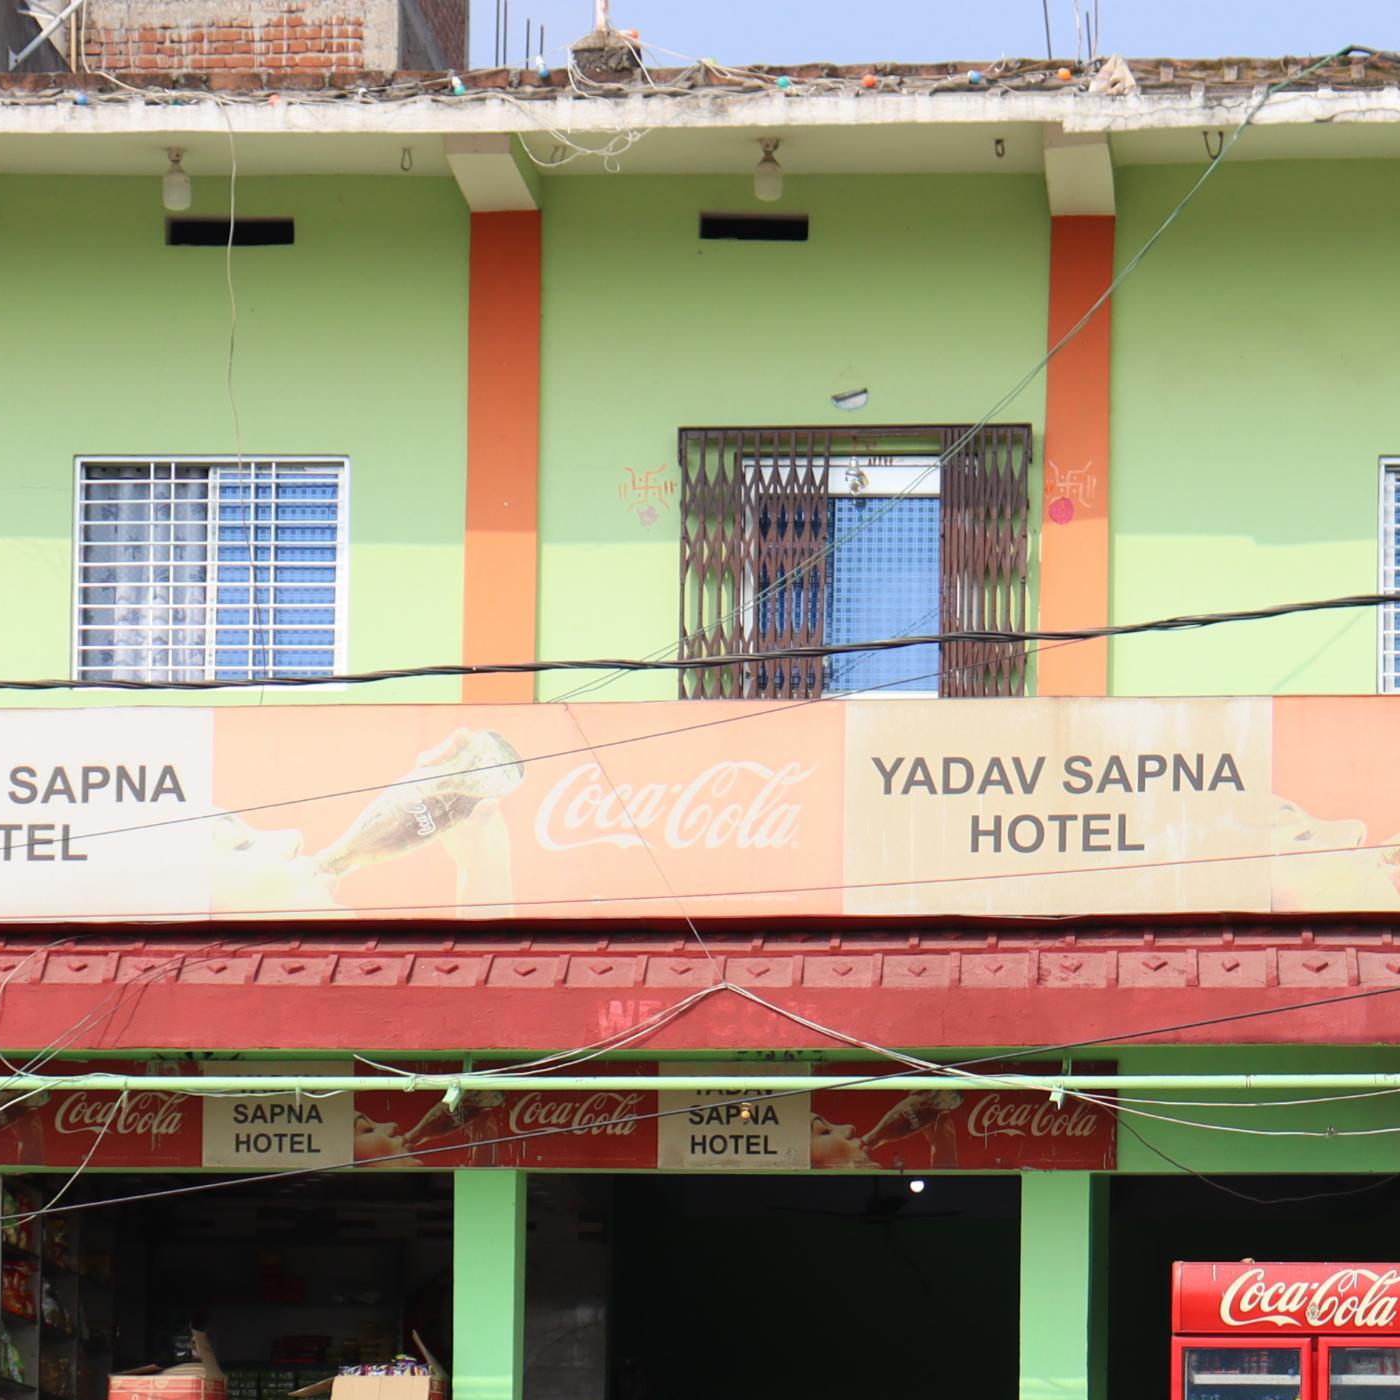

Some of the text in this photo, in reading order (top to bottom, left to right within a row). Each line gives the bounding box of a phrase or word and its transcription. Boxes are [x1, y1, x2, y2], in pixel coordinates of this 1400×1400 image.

[7, 765, 186, 804] SAPNA
[871, 753, 1246, 796] YADAV SAPNA
[534, 760, 819, 851] Coca-Cola
[969, 813, 1145, 853] HOTEL
[54, 1091, 188, 1135] Coca-Cola
[232, 1103, 323, 1125] SAPNA
[509, 1091, 642, 1137] Coca-Cola
[688, 1104, 779, 1126] SAPNA
[967, 1092, 1102, 1139] Coca-Cola
[234, 1133, 321, 1154] HOTEL
[690, 1134, 778, 1155] HOTEL
